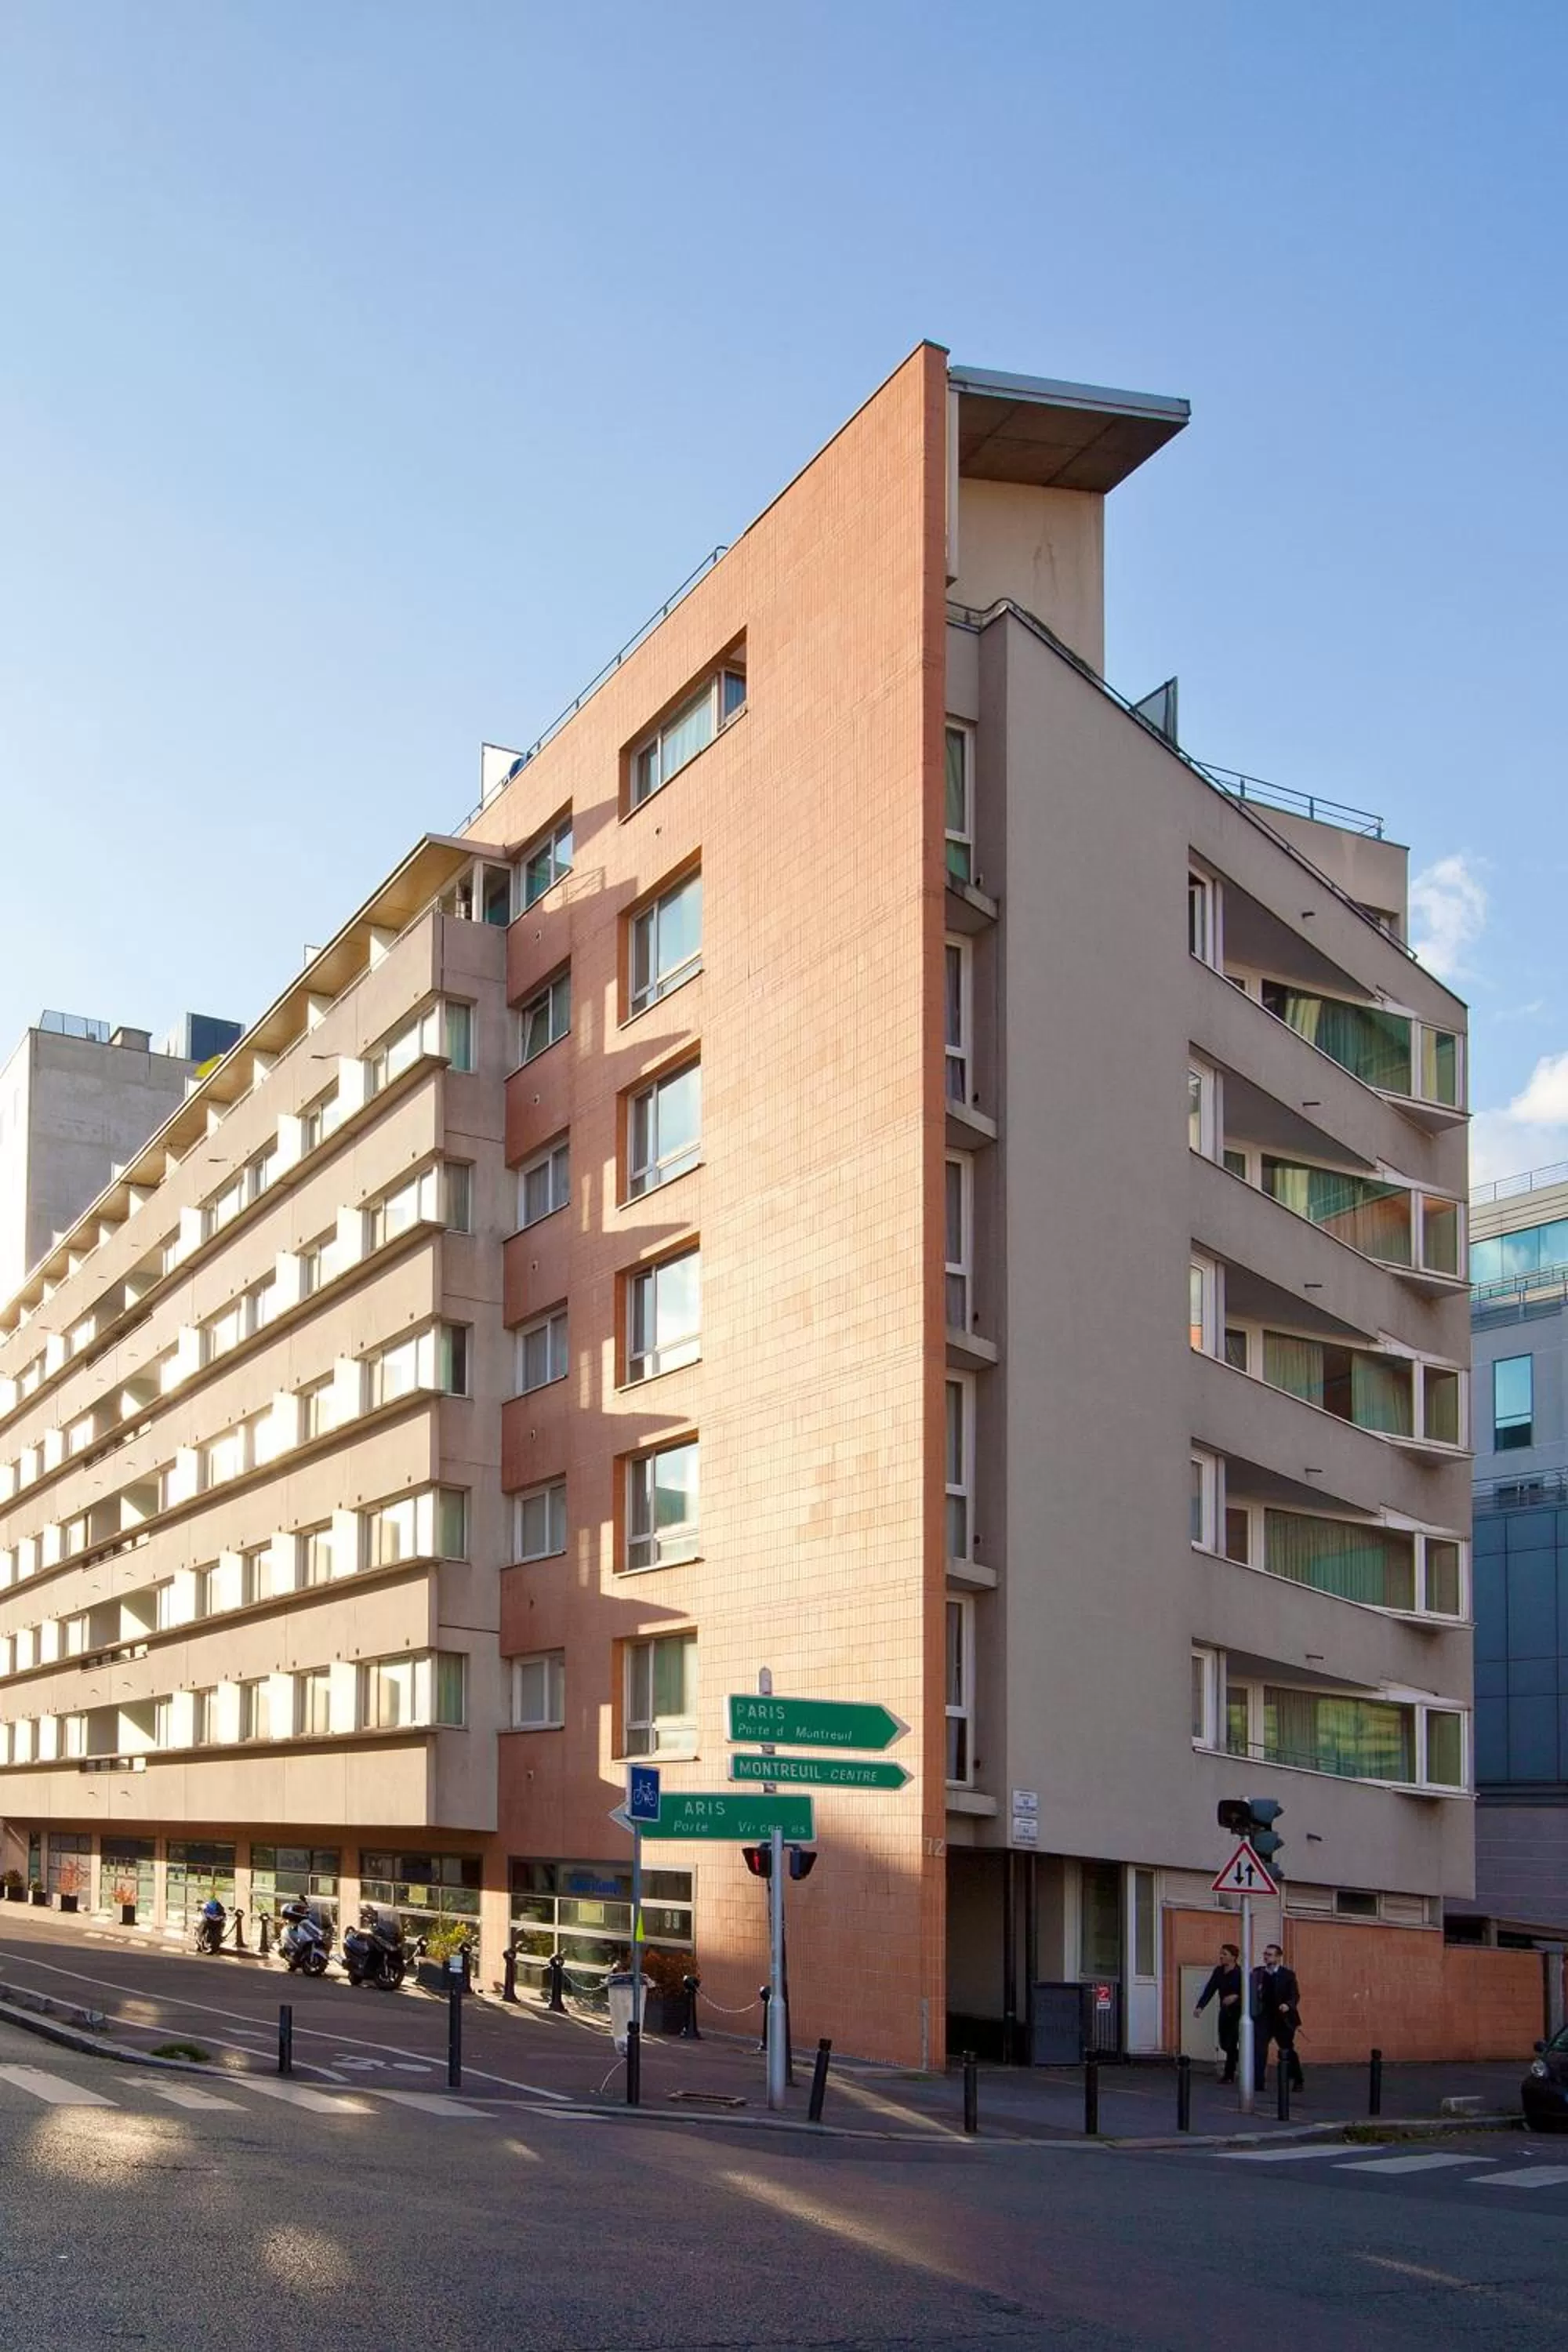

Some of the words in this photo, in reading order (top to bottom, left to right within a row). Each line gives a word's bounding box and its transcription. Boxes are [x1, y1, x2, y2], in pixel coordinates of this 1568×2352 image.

[736, 1702, 786, 1720] PARIS
[738, 1722, 770, 1736] Porte
[795, 1726, 853, 1741] Montreuil
[684, 1801, 726, 1816] ARIS
[673, 1820, 710, 1832] Porte
[923, 1837, 946, 1857] 72
